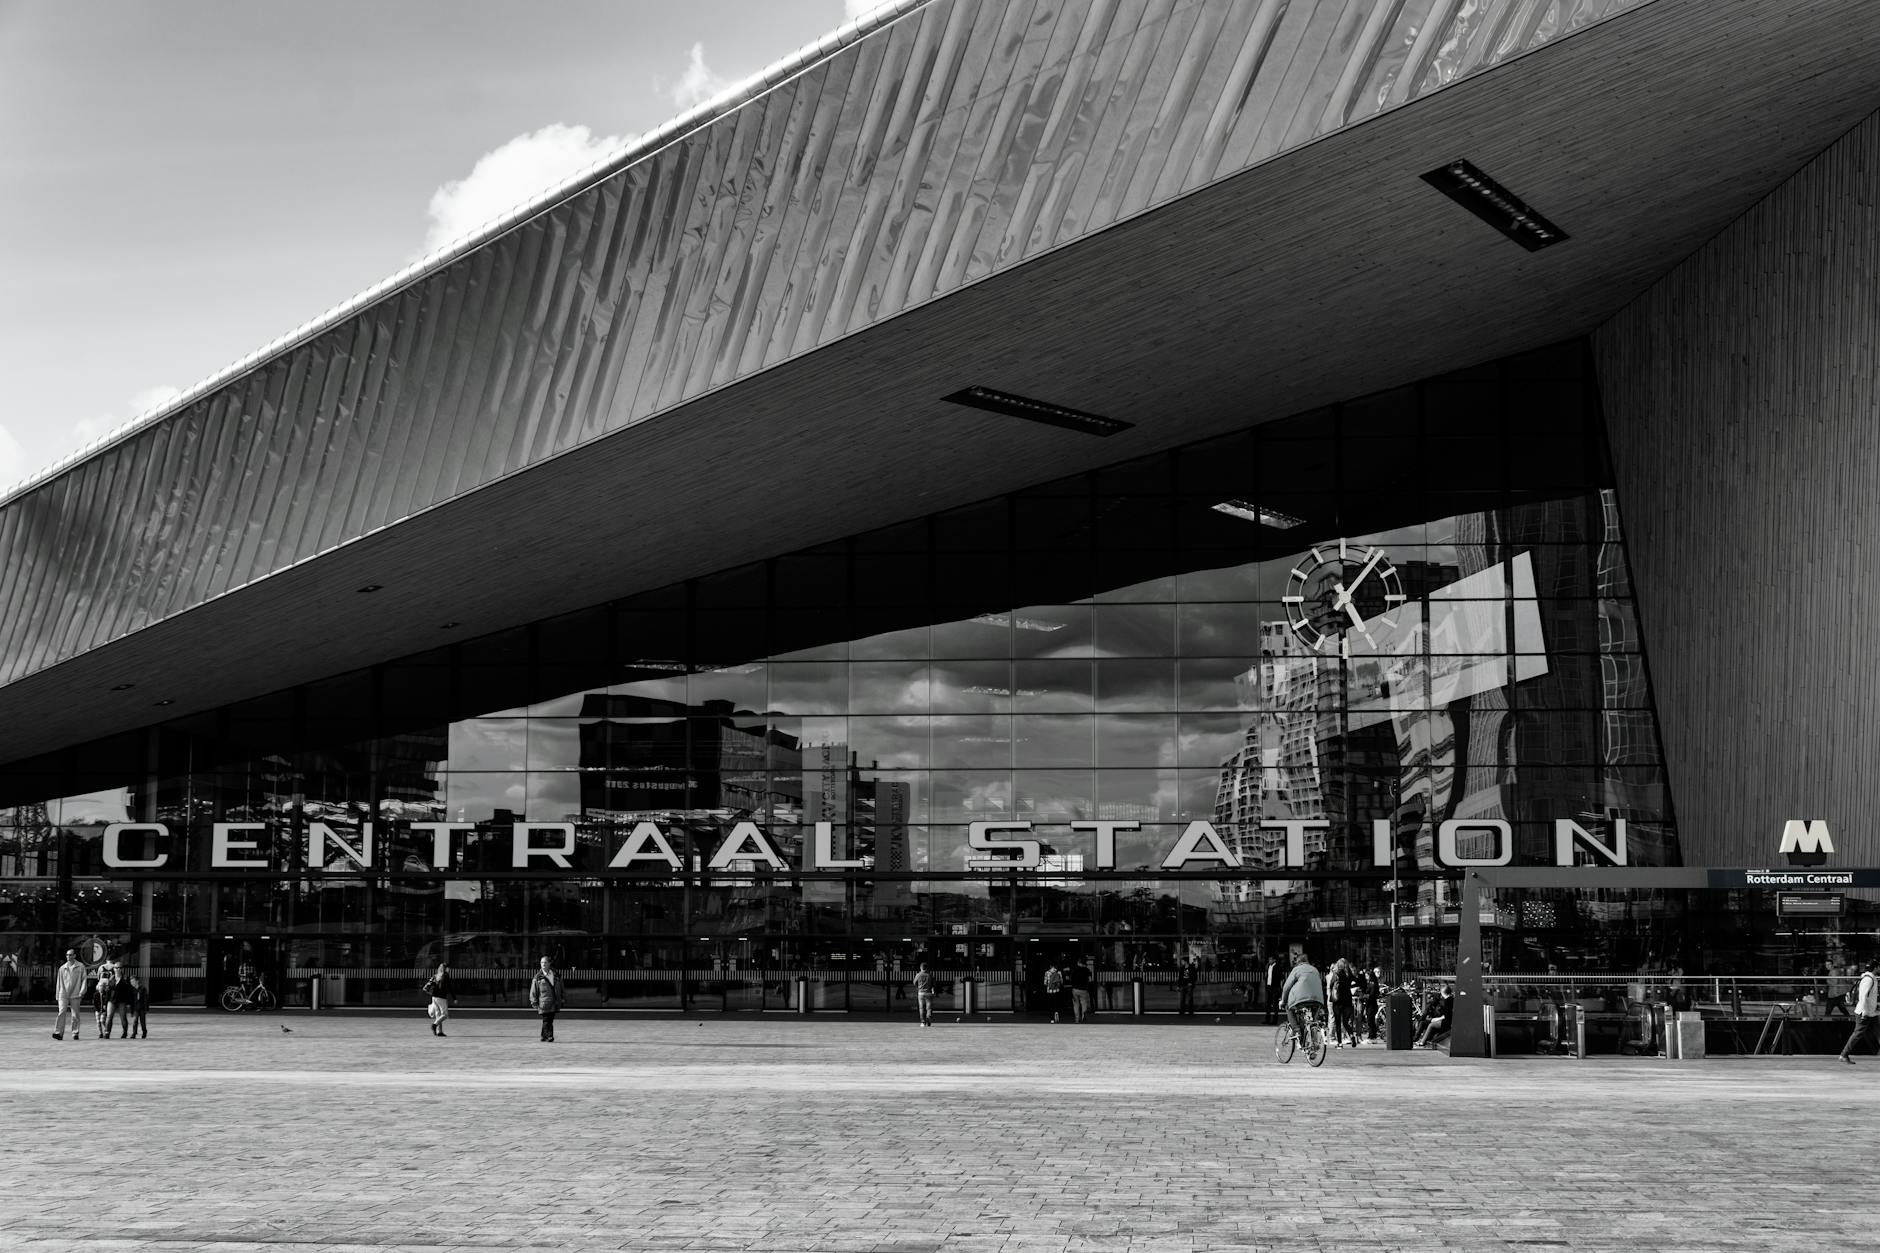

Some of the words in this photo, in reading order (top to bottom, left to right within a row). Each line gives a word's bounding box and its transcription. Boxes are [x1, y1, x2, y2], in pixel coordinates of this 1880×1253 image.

[102, 821, 865, 869] CENTRAAL
[968, 819, 1628, 868] STATION
[1747, 874, 1804, 884] Rotterdam
[1807, 873, 1853, 884] Centraal
